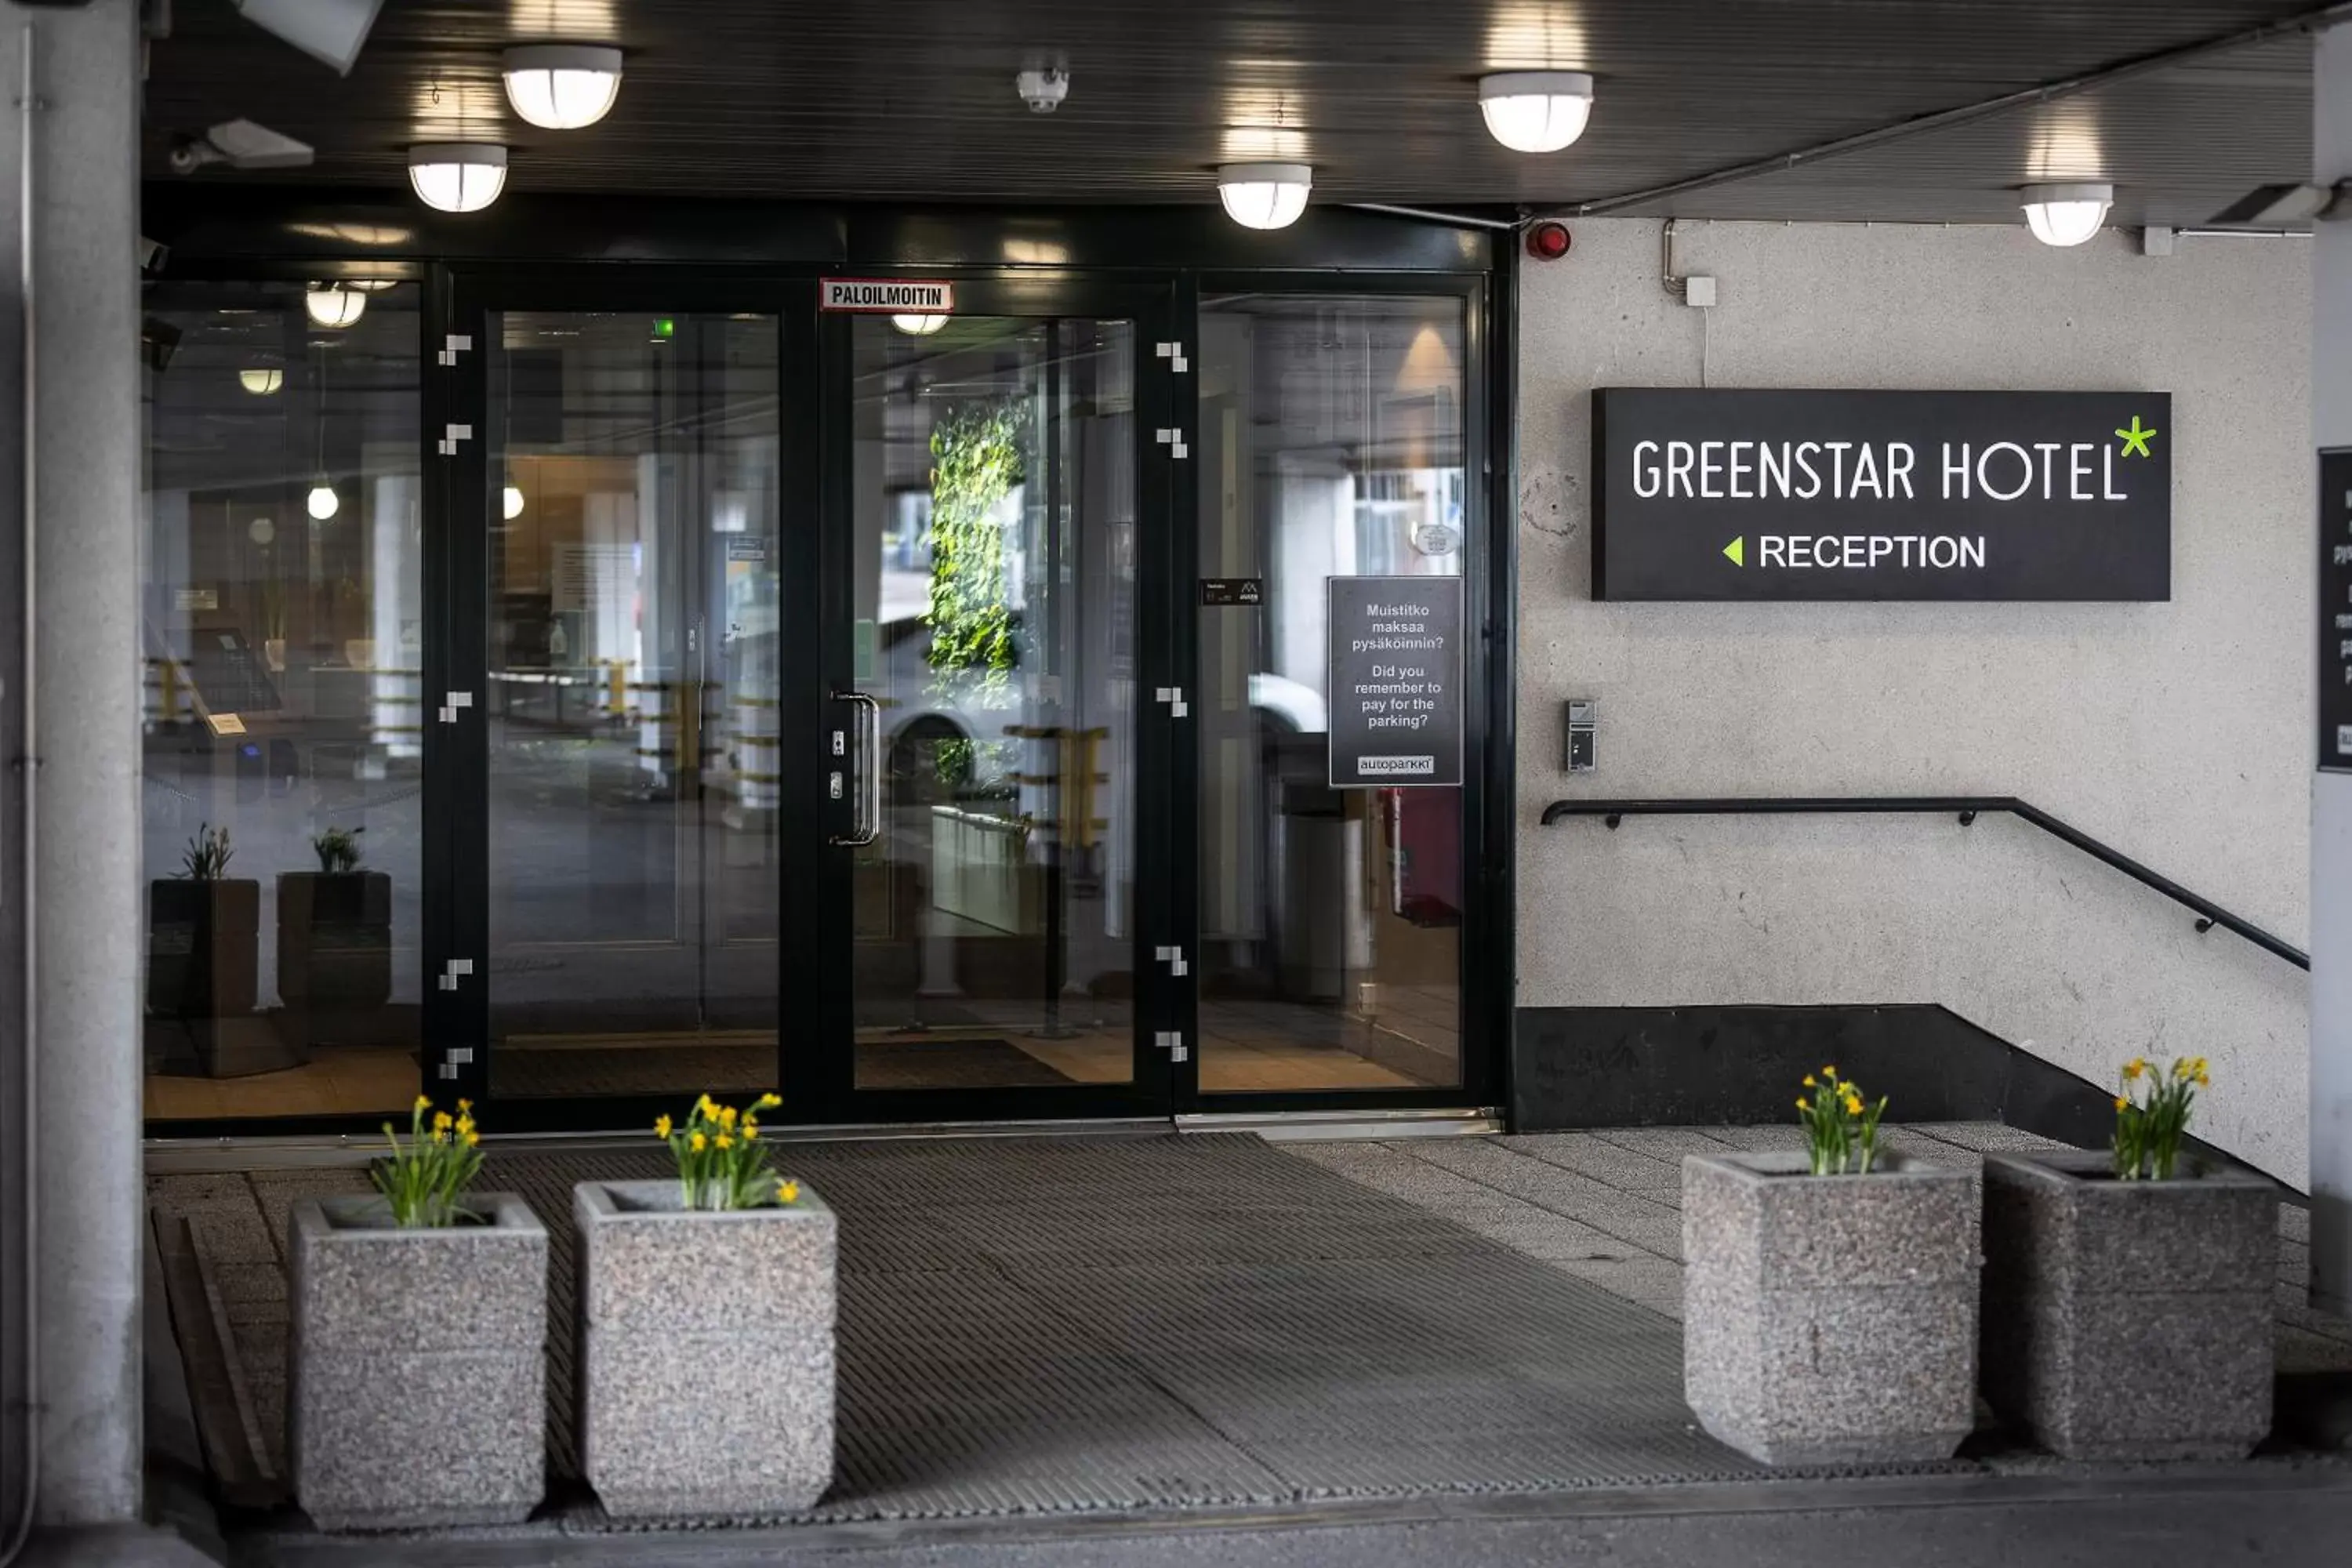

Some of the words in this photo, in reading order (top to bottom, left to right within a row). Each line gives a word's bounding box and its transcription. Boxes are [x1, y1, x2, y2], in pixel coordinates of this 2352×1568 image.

[832, 285, 942, 305] PALOILMOITIN
[1632, 440, 1915, 500] GREENSTAR
[1942, 441, 2128, 501] HOTEL
[1759, 535, 1986, 568] RECEPTION
[1367, 604, 1430, 616] Muistitko
[1372, 620, 1425, 633] maksaa
[1352, 636, 1444, 652] pysäköinnin?
[1373, 665, 1395, 677] Did
[1399, 667, 1425, 680] you
[1355, 682, 1425, 694] remember
[1428, 681, 1442, 694] to
[1362, 700, 1387, 713] pay
[1390, 697, 1410, 710] for
[1413, 698, 1435, 710] the
[1368, 713, 1428, 730] parking?
